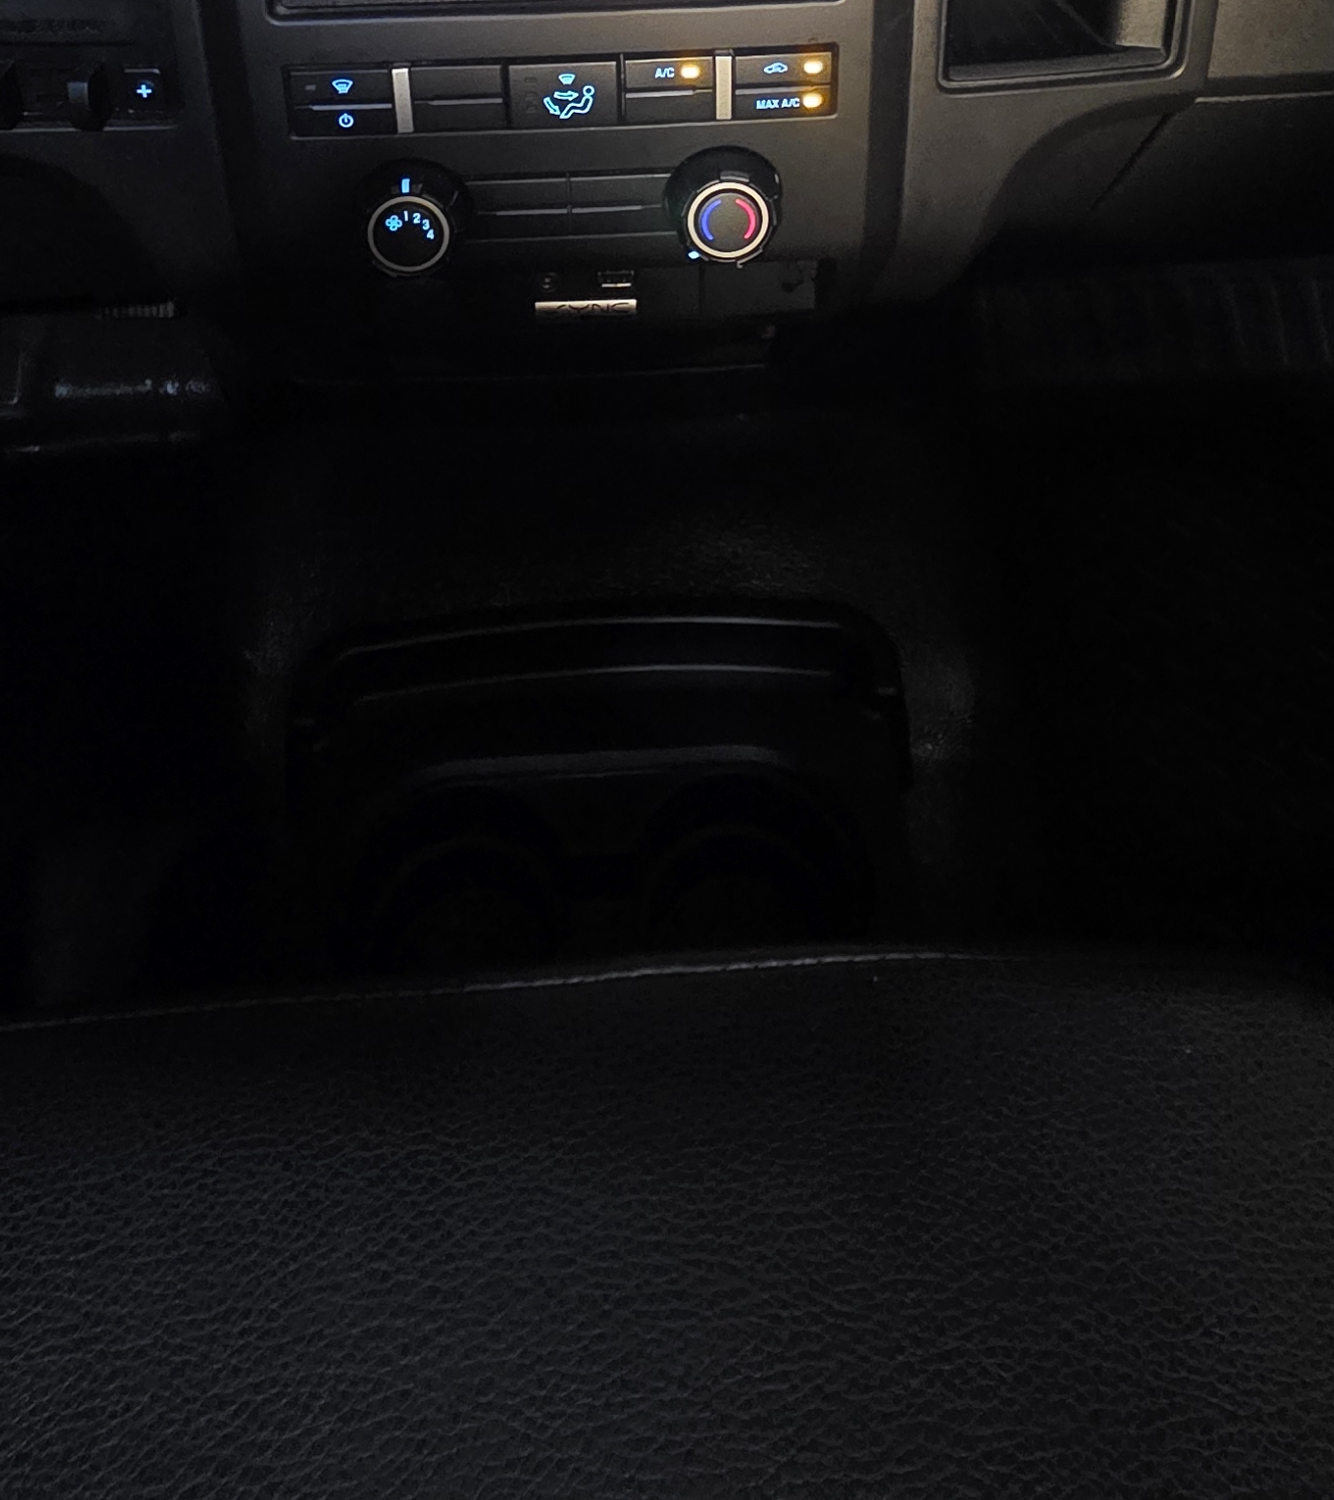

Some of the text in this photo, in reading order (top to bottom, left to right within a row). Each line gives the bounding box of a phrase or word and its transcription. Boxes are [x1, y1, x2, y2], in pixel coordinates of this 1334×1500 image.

[655, 67, 675, 79] A/C
[756, 97, 800, 110] MAX A/C
[403, 210, 435, 240] 1 2 3 4
